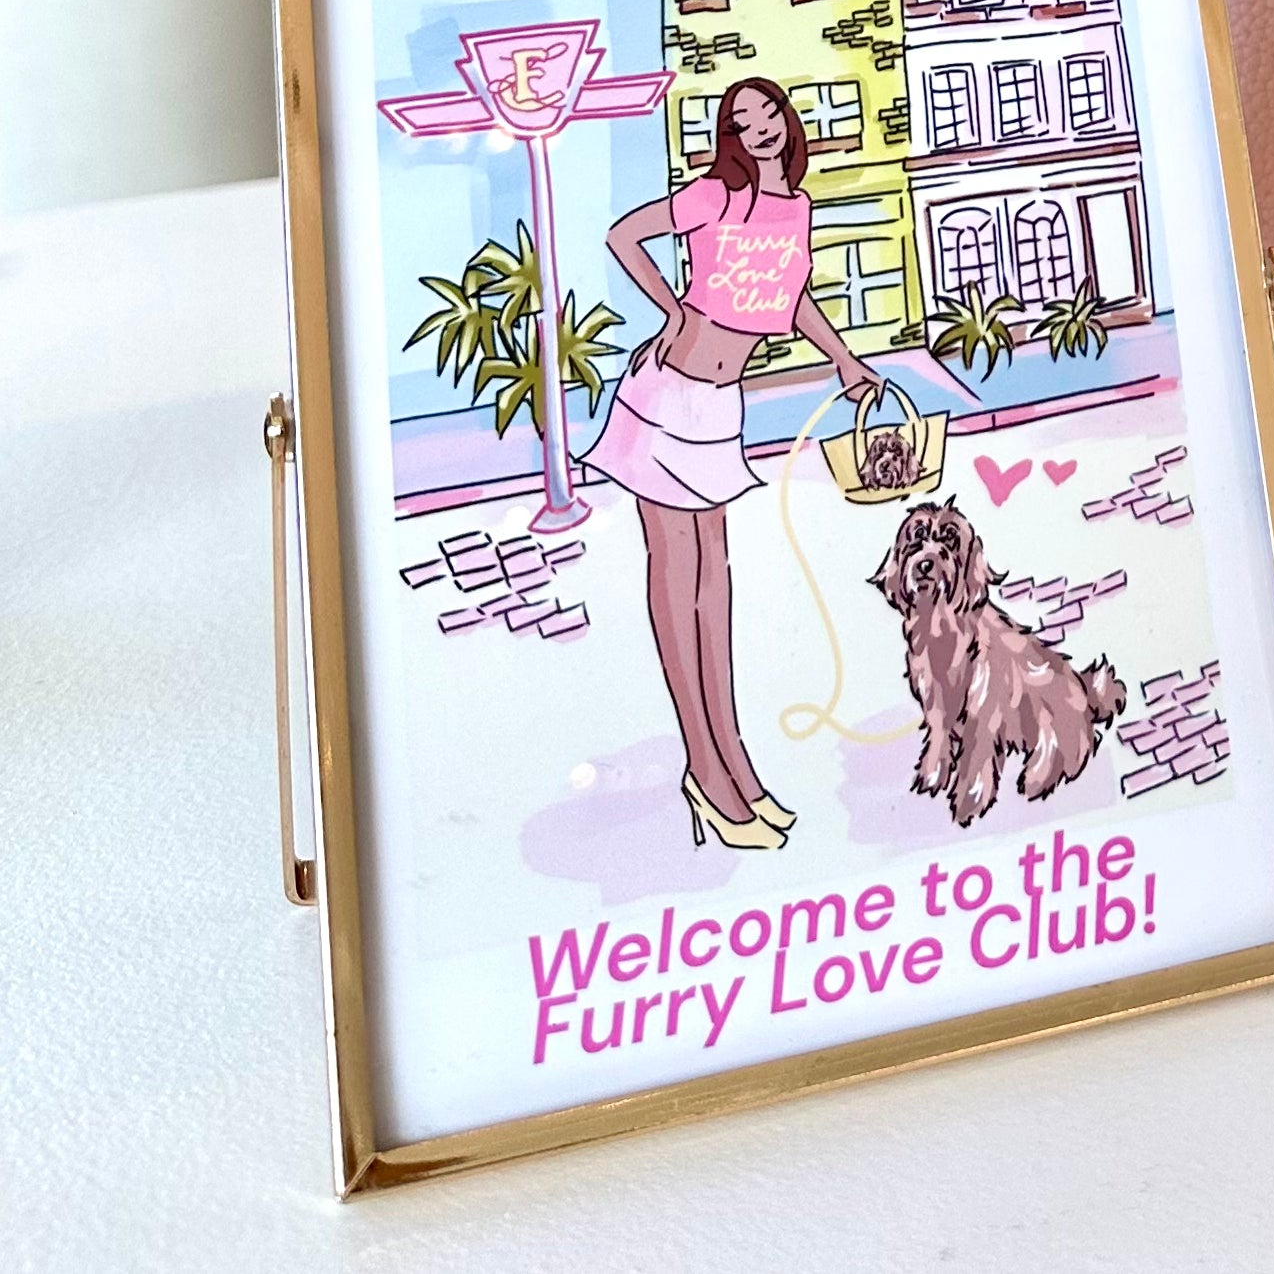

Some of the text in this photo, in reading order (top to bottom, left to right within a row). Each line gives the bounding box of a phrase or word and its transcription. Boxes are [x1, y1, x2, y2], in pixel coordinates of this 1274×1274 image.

[715, 224, 803, 268] Furry
[707, 256, 784, 293] Love
[732, 284, 791, 314] Club
[528, 829, 1137, 999] Welcome to the
[533, 872, 1158, 1065] Furry Love Club!
